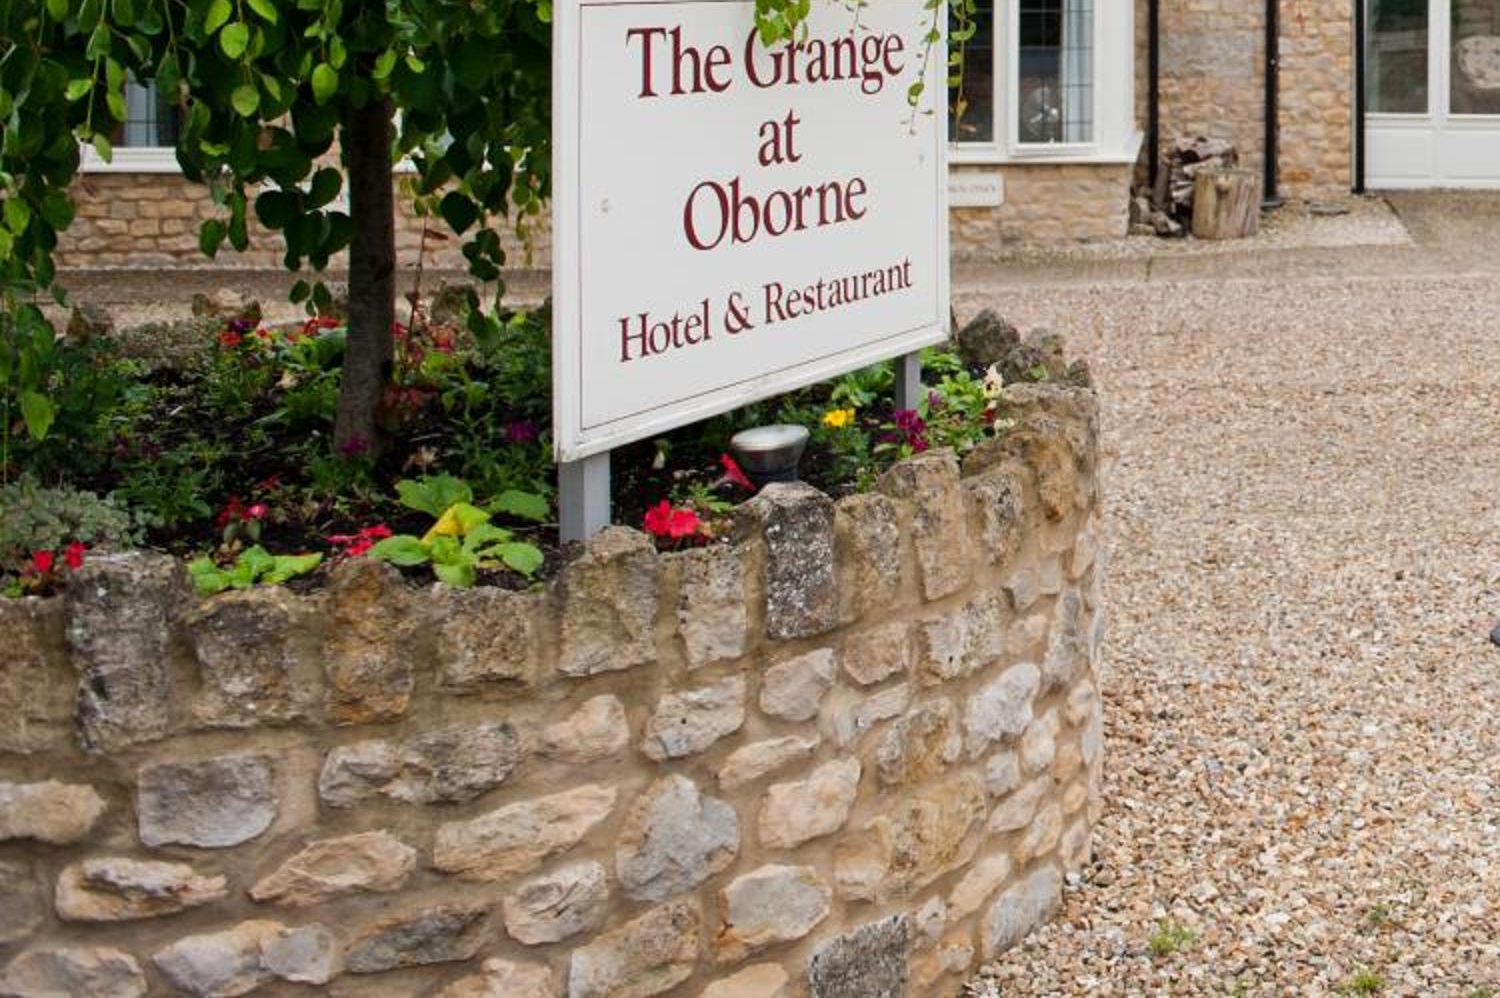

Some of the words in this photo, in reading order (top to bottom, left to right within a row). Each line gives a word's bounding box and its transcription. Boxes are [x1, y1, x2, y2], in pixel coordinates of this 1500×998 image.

[627, 24, 732, 98] The
[744, 25, 905, 95] Grange
[758, 109, 803, 167] at
[683, 176, 867, 251] Oborne
[619, 298, 710, 363] Hotel
[724, 291, 754, 335] &
[764, 256, 914, 323] Restaurant
